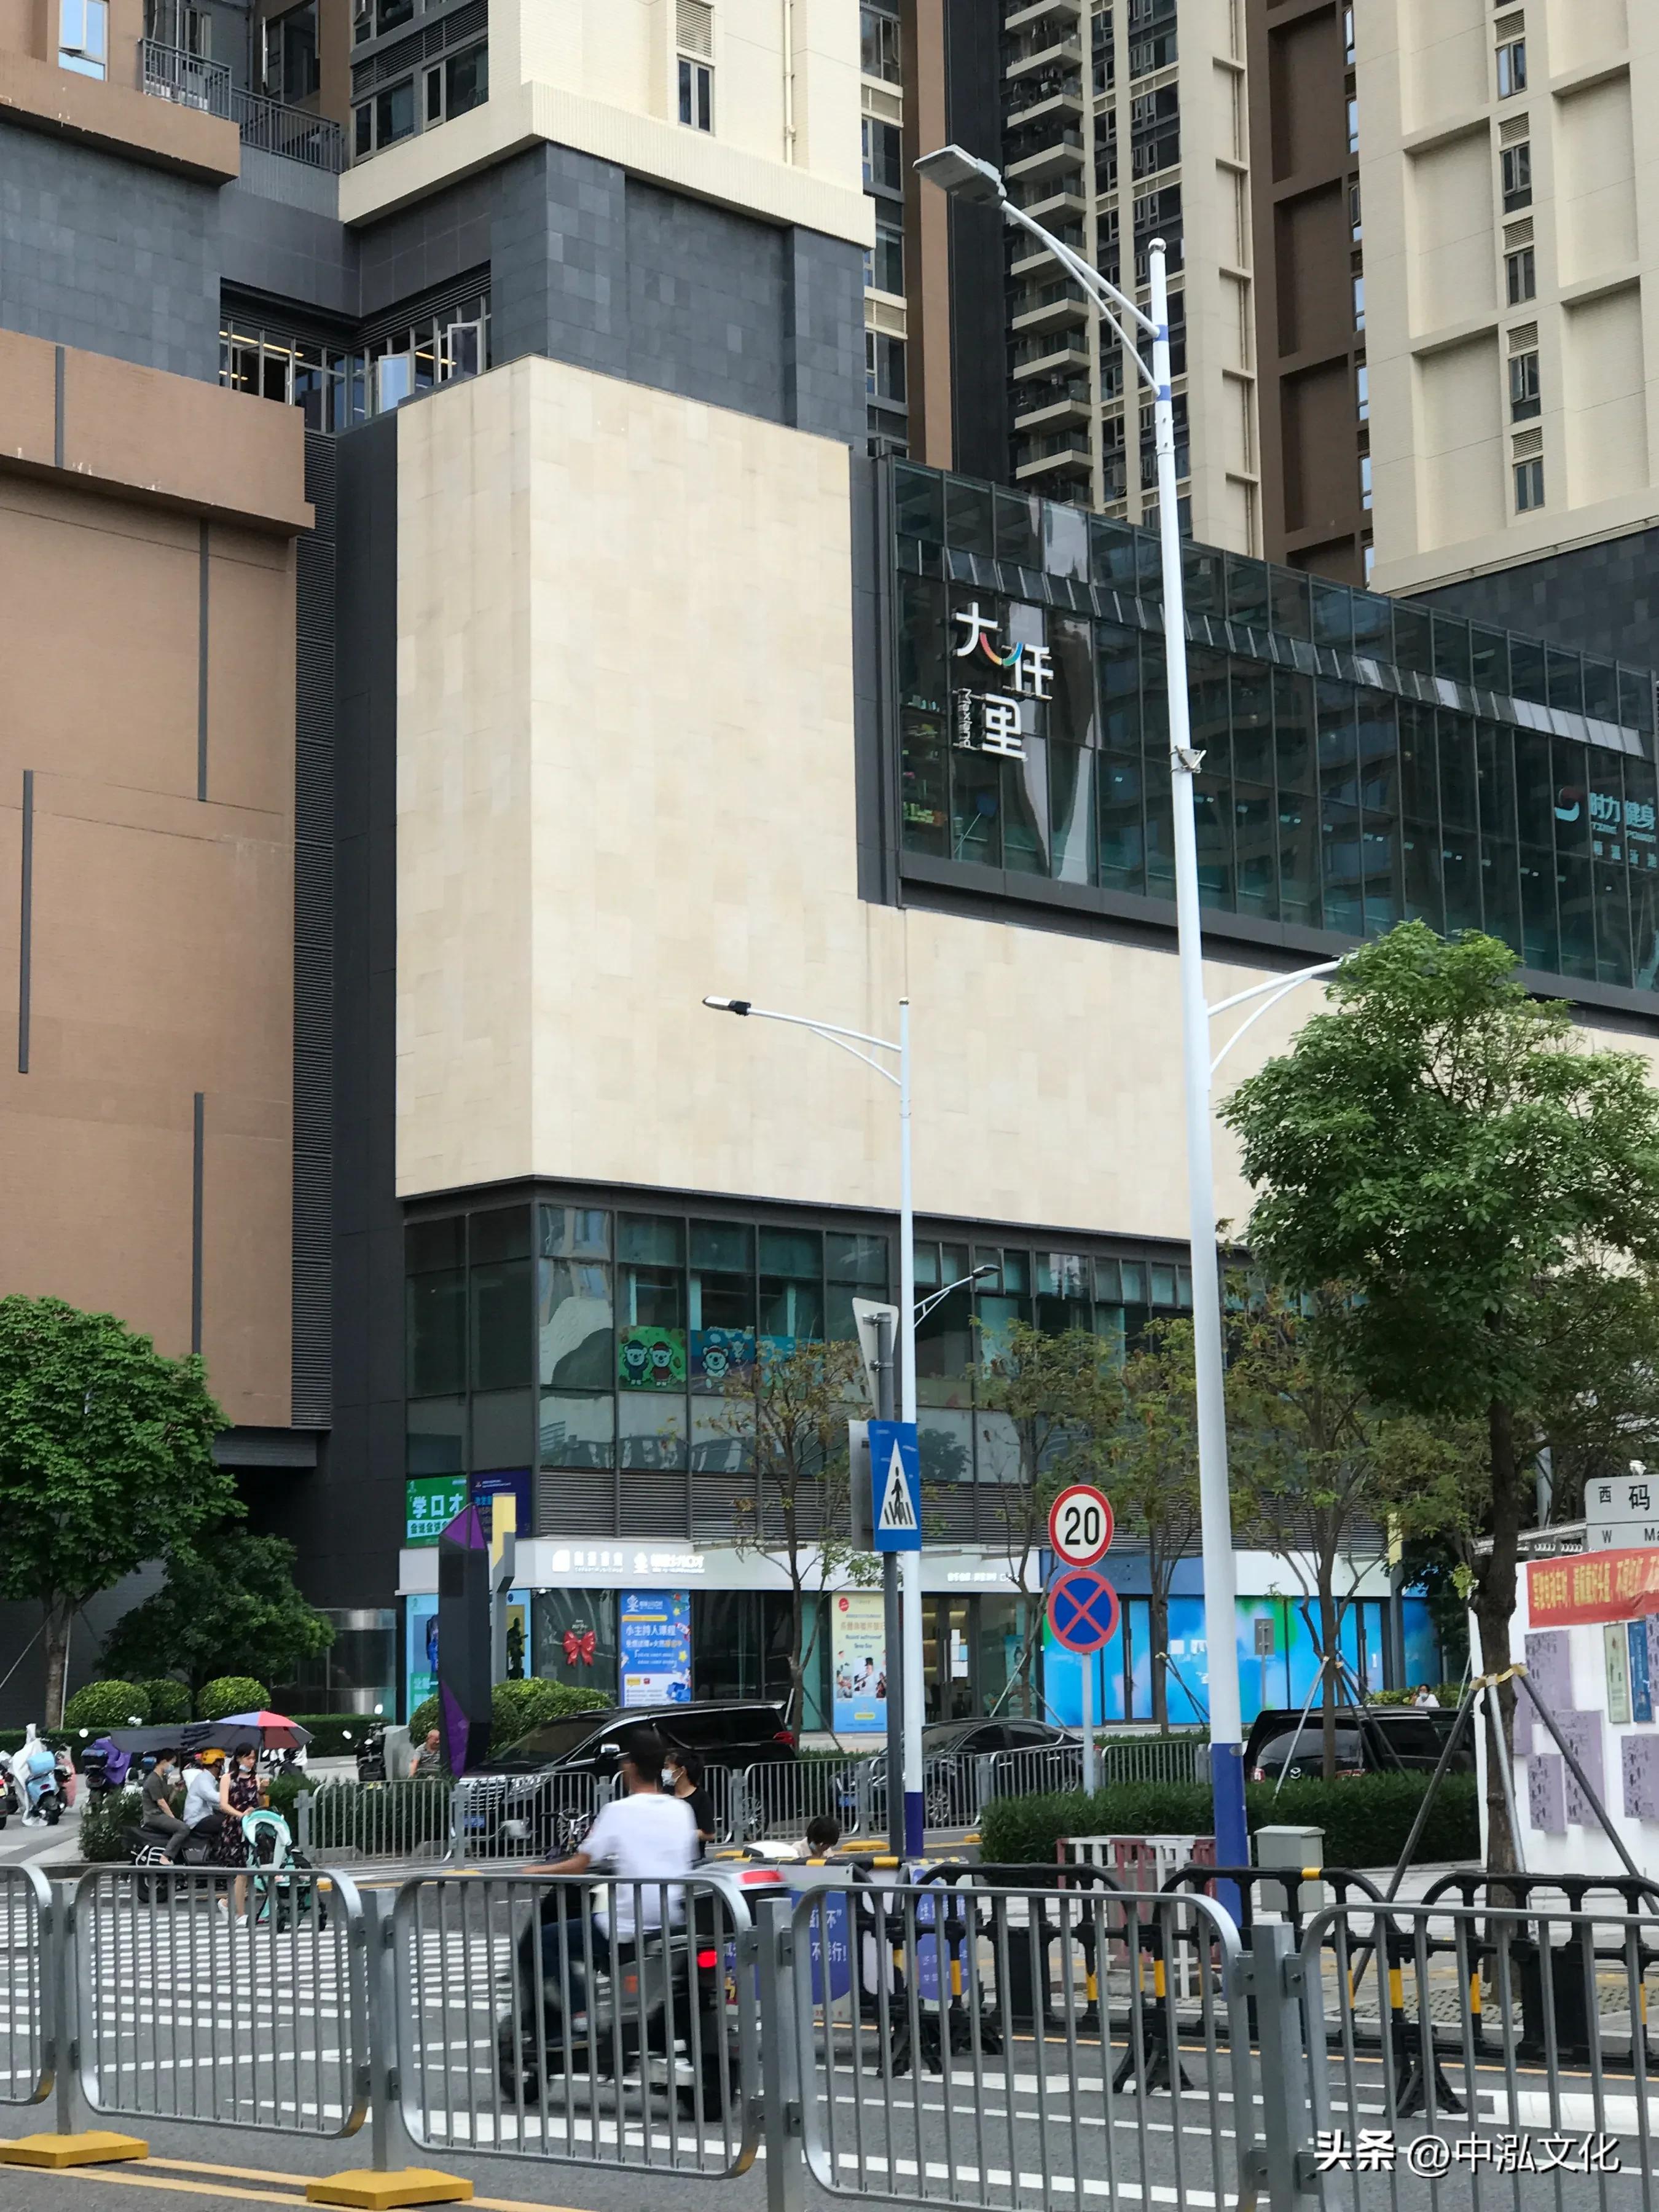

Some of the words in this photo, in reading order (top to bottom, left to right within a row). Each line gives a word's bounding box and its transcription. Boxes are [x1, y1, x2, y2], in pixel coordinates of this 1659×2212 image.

[1598, 1486, 1612, 1504] 西
[1628, 1484, 1650, 1511] 码
[1064, 1506, 1100, 1546] 20
[1602, 1530, 1612, 1543] W
